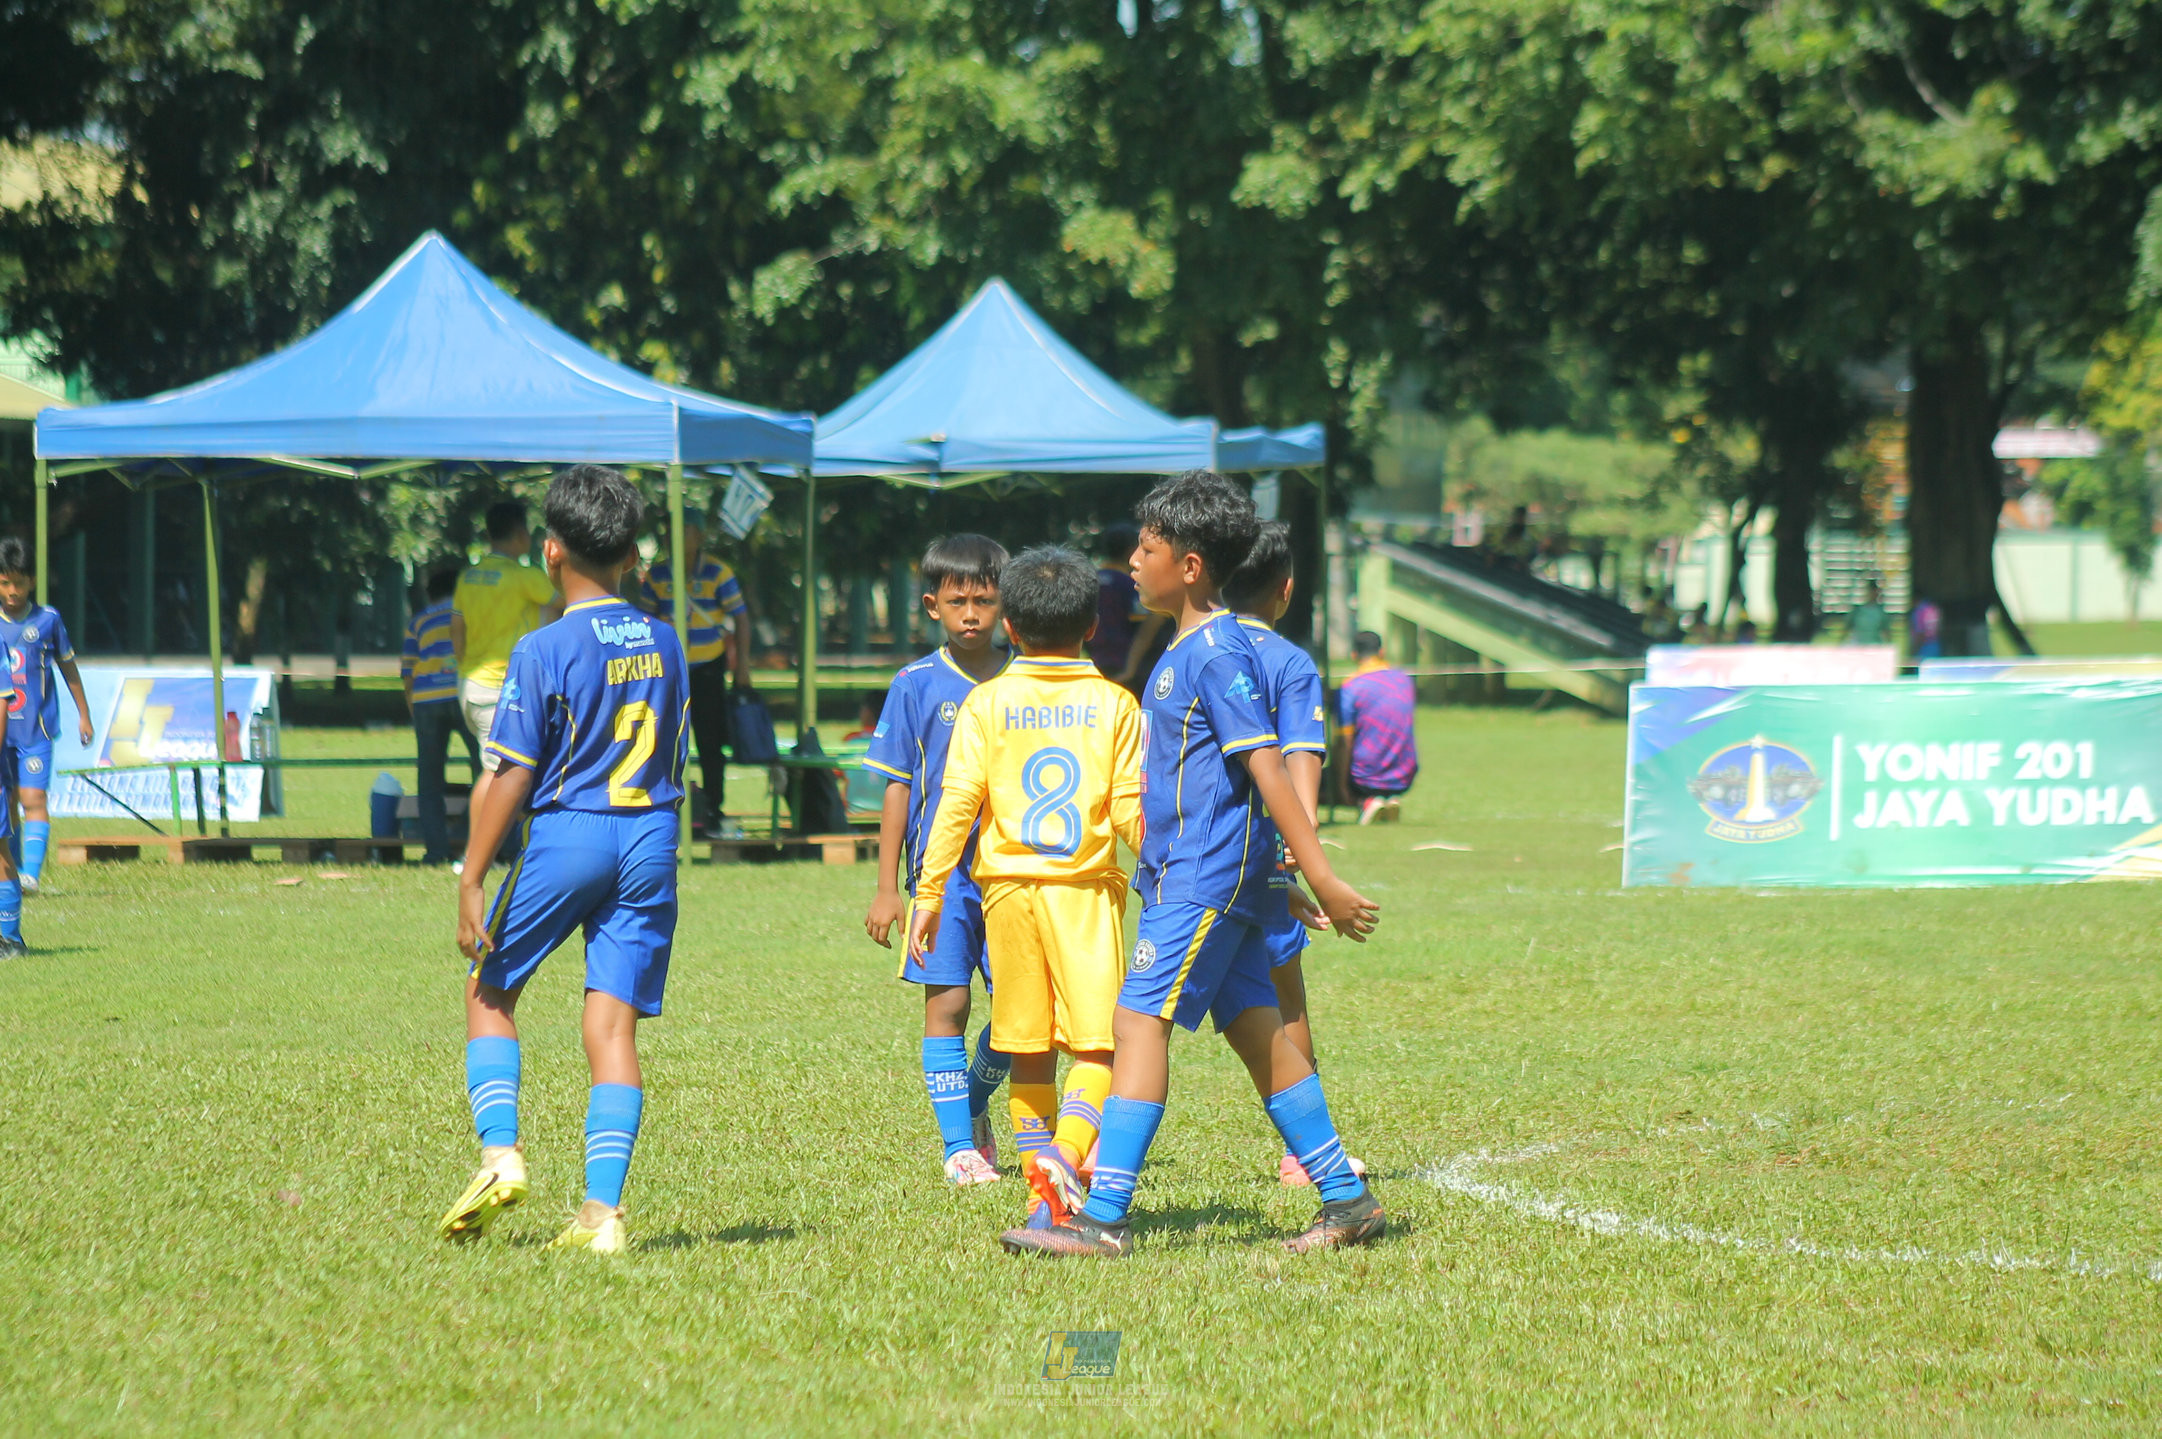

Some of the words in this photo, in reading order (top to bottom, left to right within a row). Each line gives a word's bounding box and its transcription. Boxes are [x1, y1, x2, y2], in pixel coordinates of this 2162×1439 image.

[607, 652, 663, 686] ARKHA
[1005, 705, 1097, 730] HABIBIE
[139, 733, 217, 763] Leagu
[607, 701, 658, 807] 2
[1854, 740, 2003, 782] YONIF
[2013, 739, 2095, 780] 201
[1021, 747, 1081, 858] 8
[1852, 787, 1971, 828] JAYA
[1984, 784, 2156, 826] YUDHA
